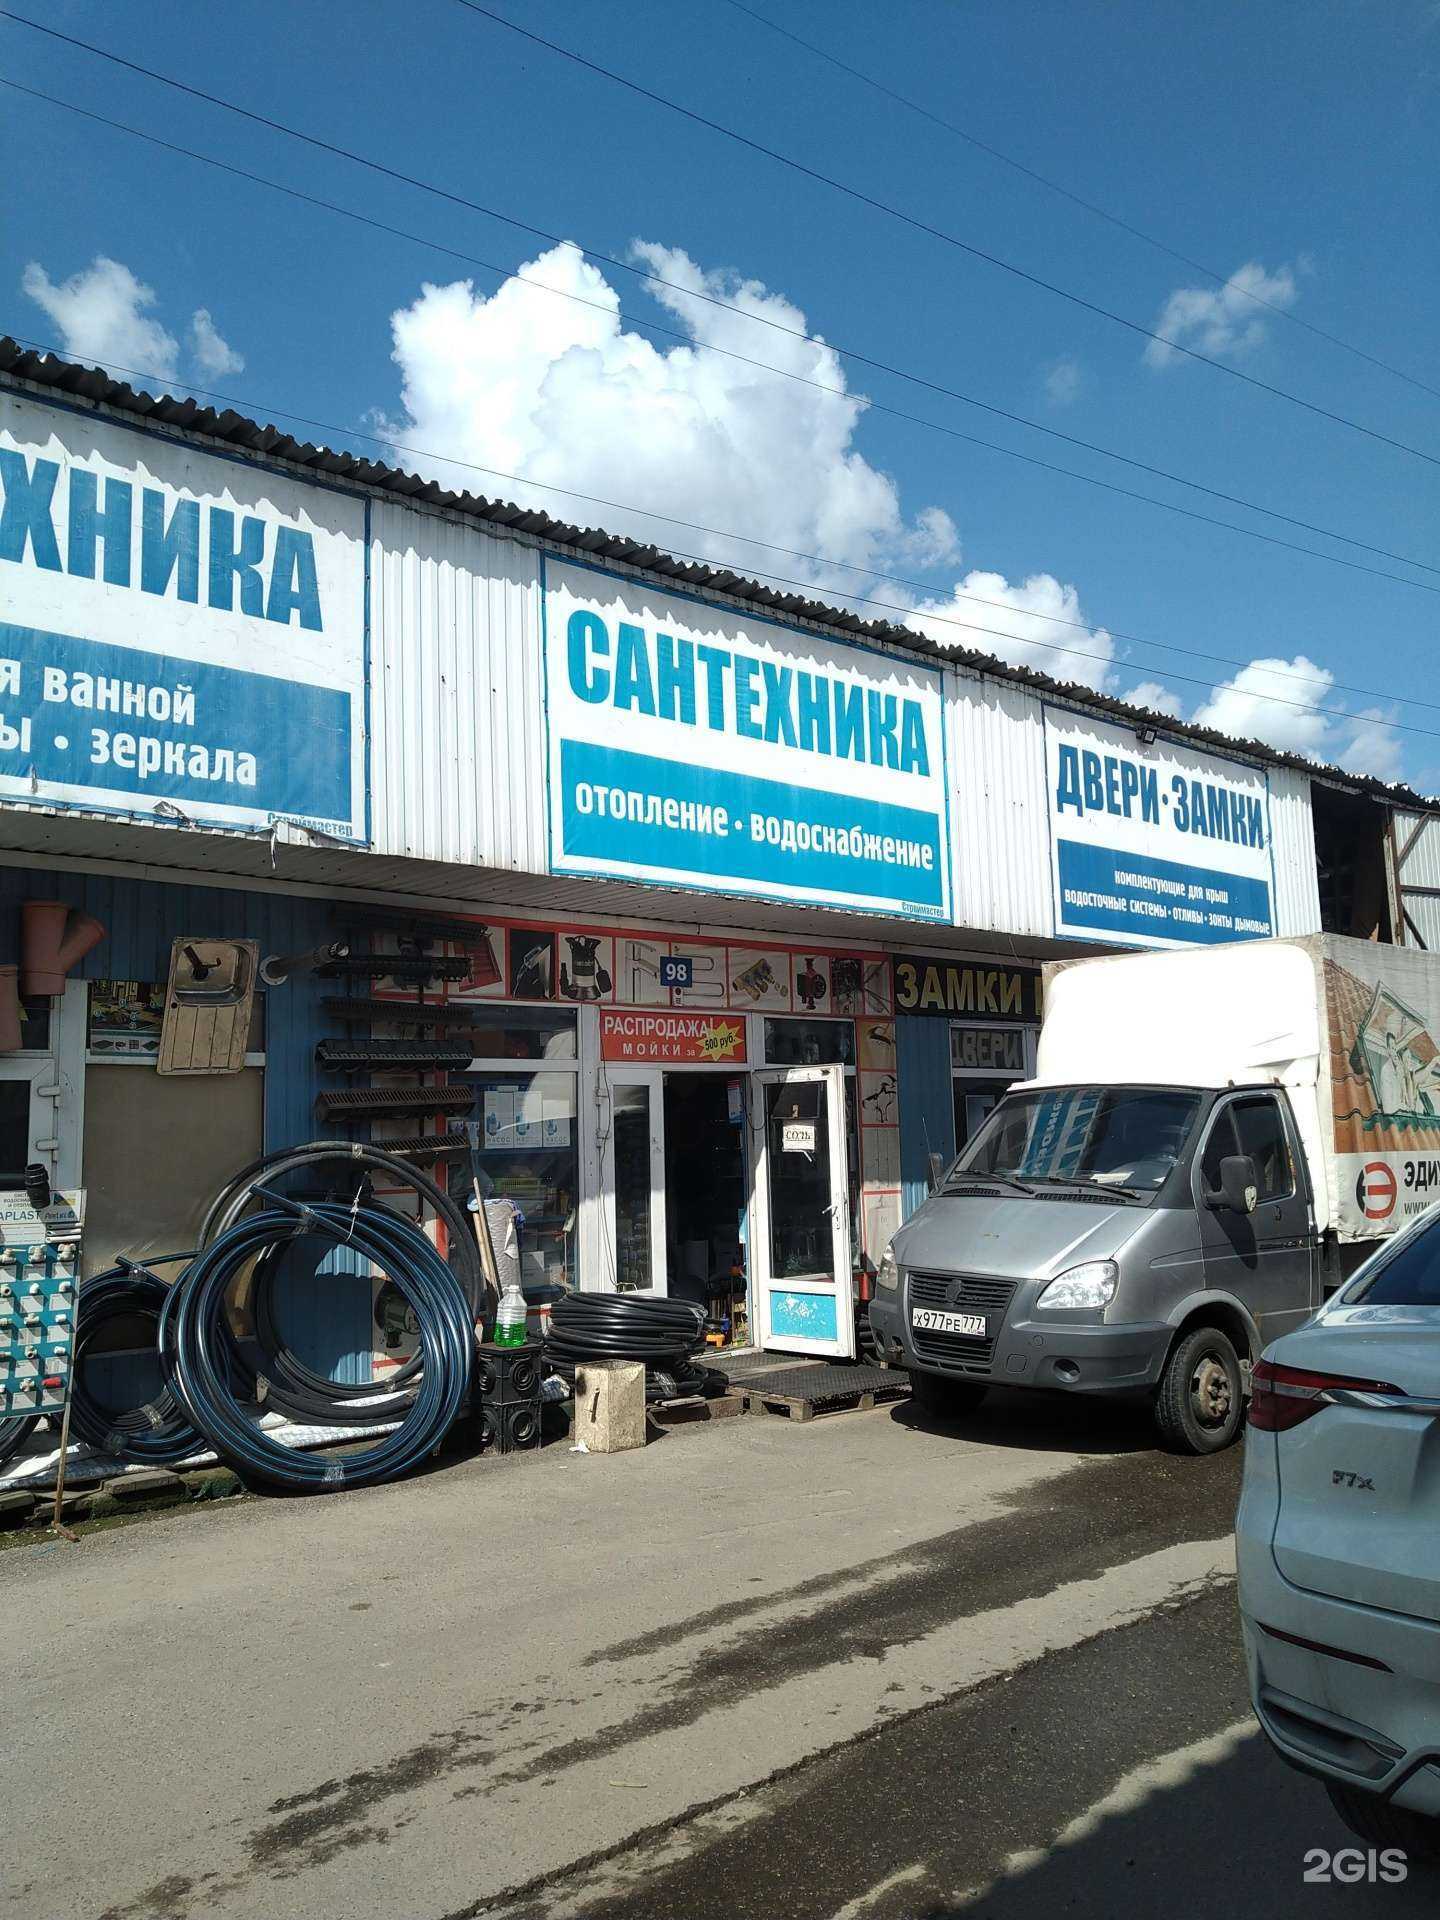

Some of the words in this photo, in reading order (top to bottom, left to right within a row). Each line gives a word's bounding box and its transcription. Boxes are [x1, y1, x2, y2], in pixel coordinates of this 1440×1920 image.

[0, 447, 323, 632] ХНИКА
[43, 666, 195, 726] ванной
[567, 609, 930, 777] САНТЕХНИКА
[90, 728, 257, 786] зеркала
[1056, 743, 1160, 825] ДВЕРИ
[1171, 774, 1264, 850] ЗАМКИ
[575, 782, 729, 836] отопление
[751, 813, 933, 871] водоснабжение
[1064, 888, 1127, 911] водосточные
[1129, 899, 1168, 918] системы
[1172, 906, 1203, 924] отливы
[1208, 912, 1233, 929] зонты
[1234, 917, 1270, 935] дымовые
[1114, 870, 1186, 898] комплектующие
[1188, 884, 1204, 900] для
[1206, 887, 1228, 904] крыш
[665, 963, 688, 981] 98
[896, 963, 1023, 1015] ЗАМКИ
[704, 1038, 719, 1051] 500
[1404, 1160, 1440, 1192] ЭДИ
